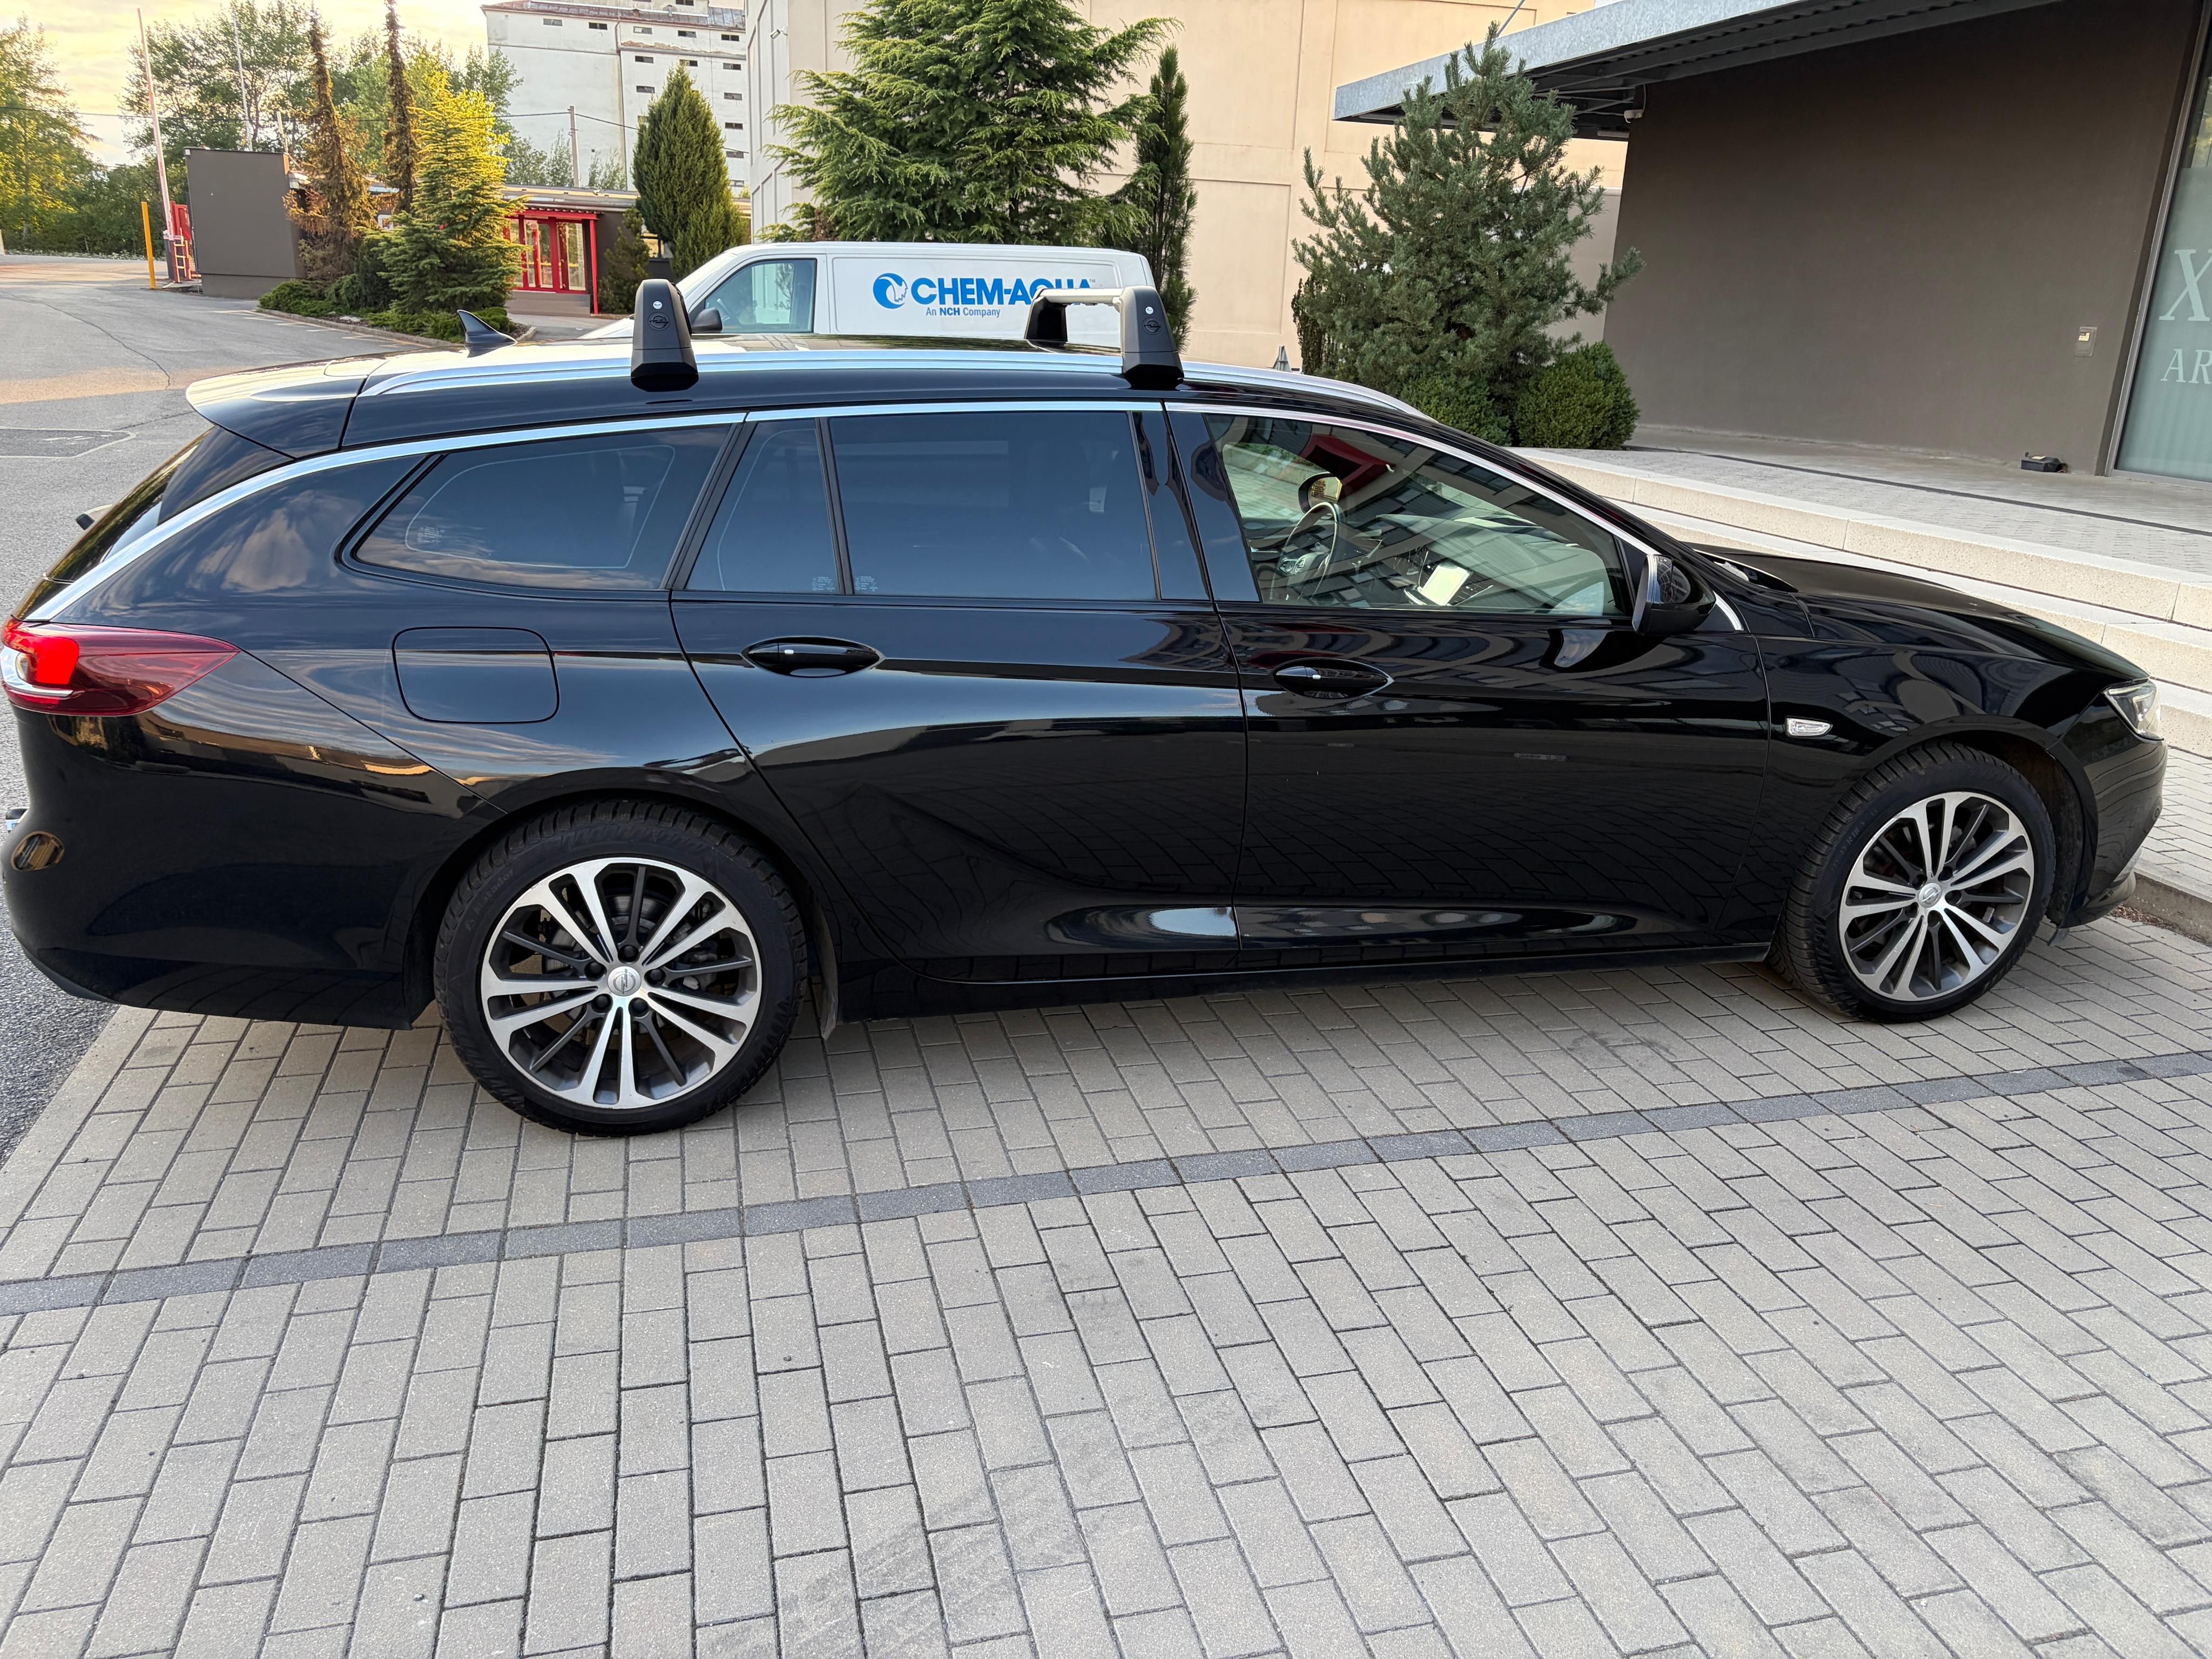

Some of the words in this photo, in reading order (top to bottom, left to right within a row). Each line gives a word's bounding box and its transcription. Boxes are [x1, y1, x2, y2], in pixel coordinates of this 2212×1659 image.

[926, 307, 936, 315] An
[940, 307, 960, 316] NCH
[963, 307, 1000, 318] Company
